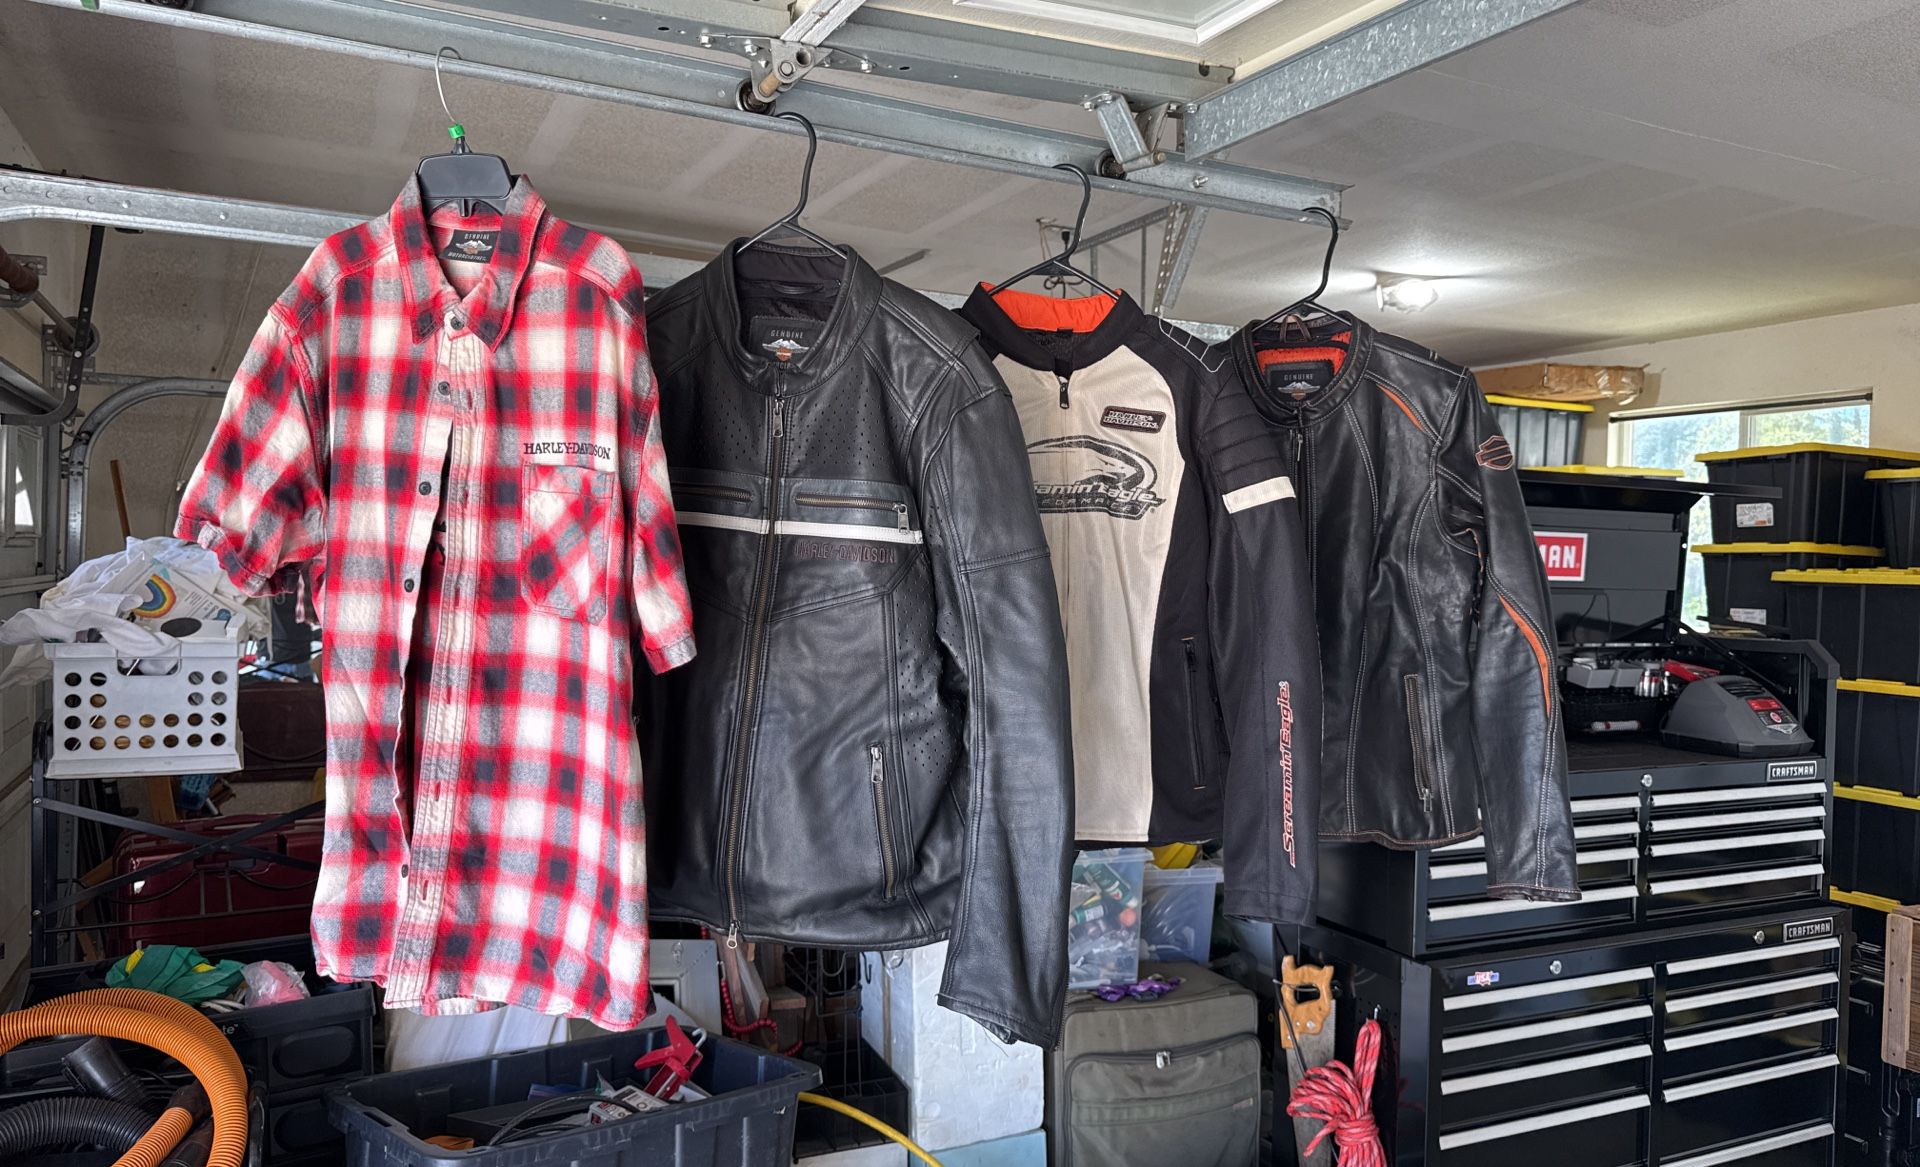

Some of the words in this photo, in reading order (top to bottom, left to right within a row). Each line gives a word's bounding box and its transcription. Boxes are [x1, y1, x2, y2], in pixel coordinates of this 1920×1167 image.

[770, 329, 804, 339] GENUINE
[1283, 373, 1313, 381] GENUINE
[1771, 765, 1814, 778] CRAFTSMAN
[1788, 922, 1831, 938] CRAFTSMAN
